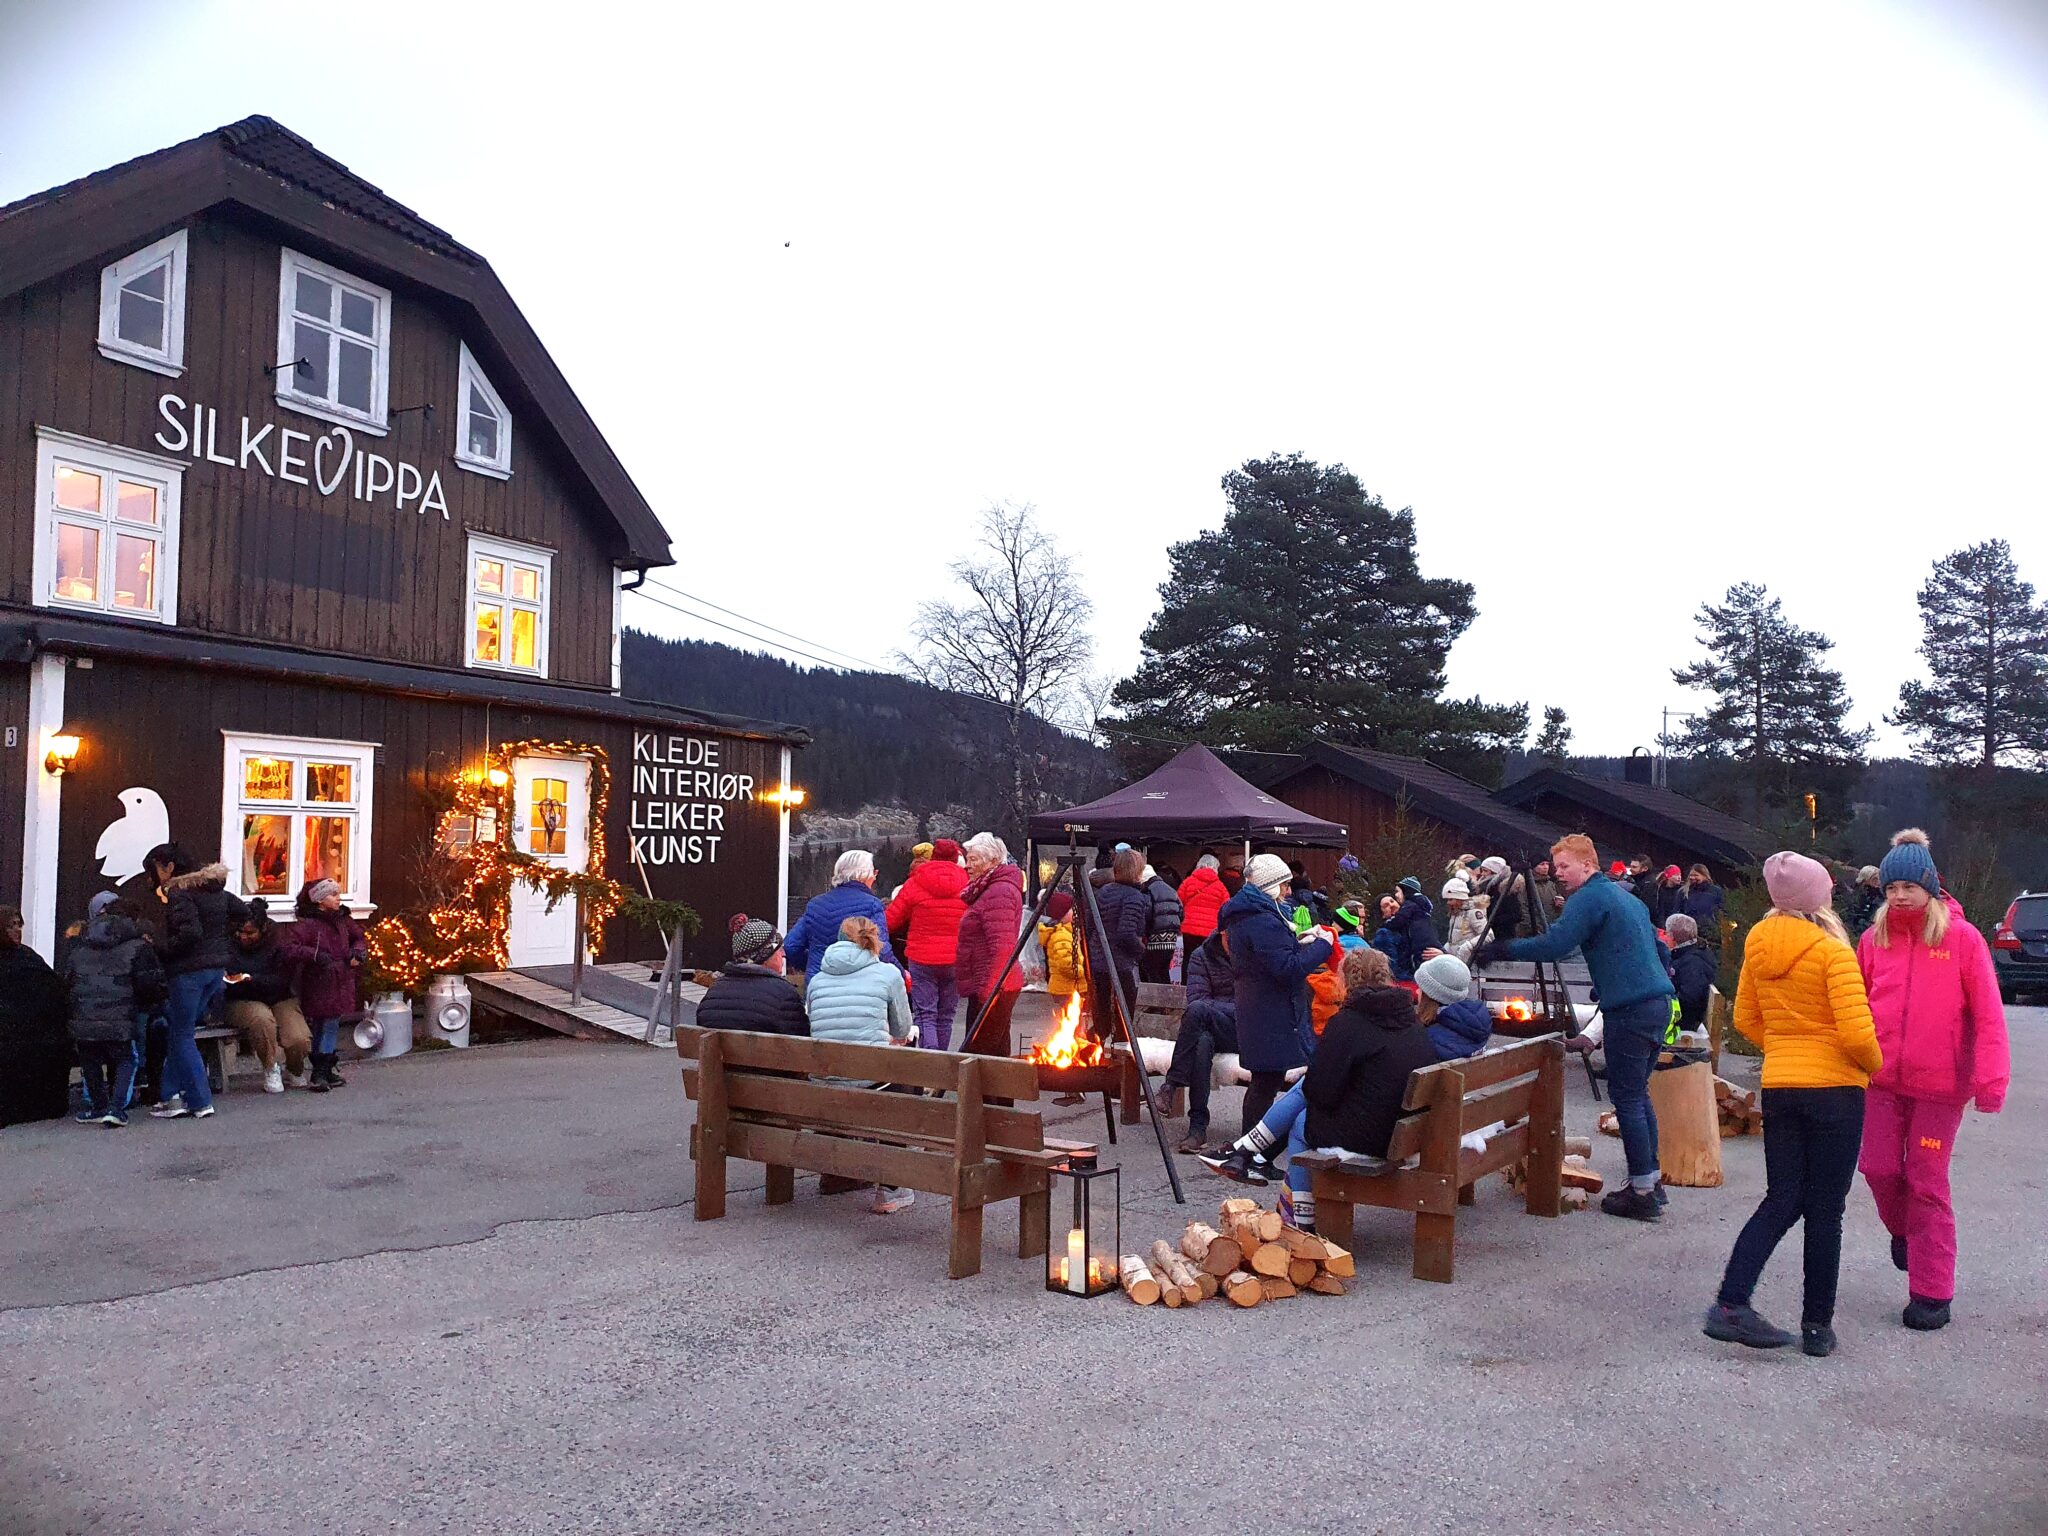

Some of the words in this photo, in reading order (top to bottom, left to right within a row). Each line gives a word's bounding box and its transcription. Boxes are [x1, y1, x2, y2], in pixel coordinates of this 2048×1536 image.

[633, 731, 720, 767] KLEDE
[632, 764, 754, 801] INTERIØR
[630, 800, 725, 831] LEIKER
[629, 836, 721, 865] KUNST
[1920, 1136, 1941, 1150] HH
